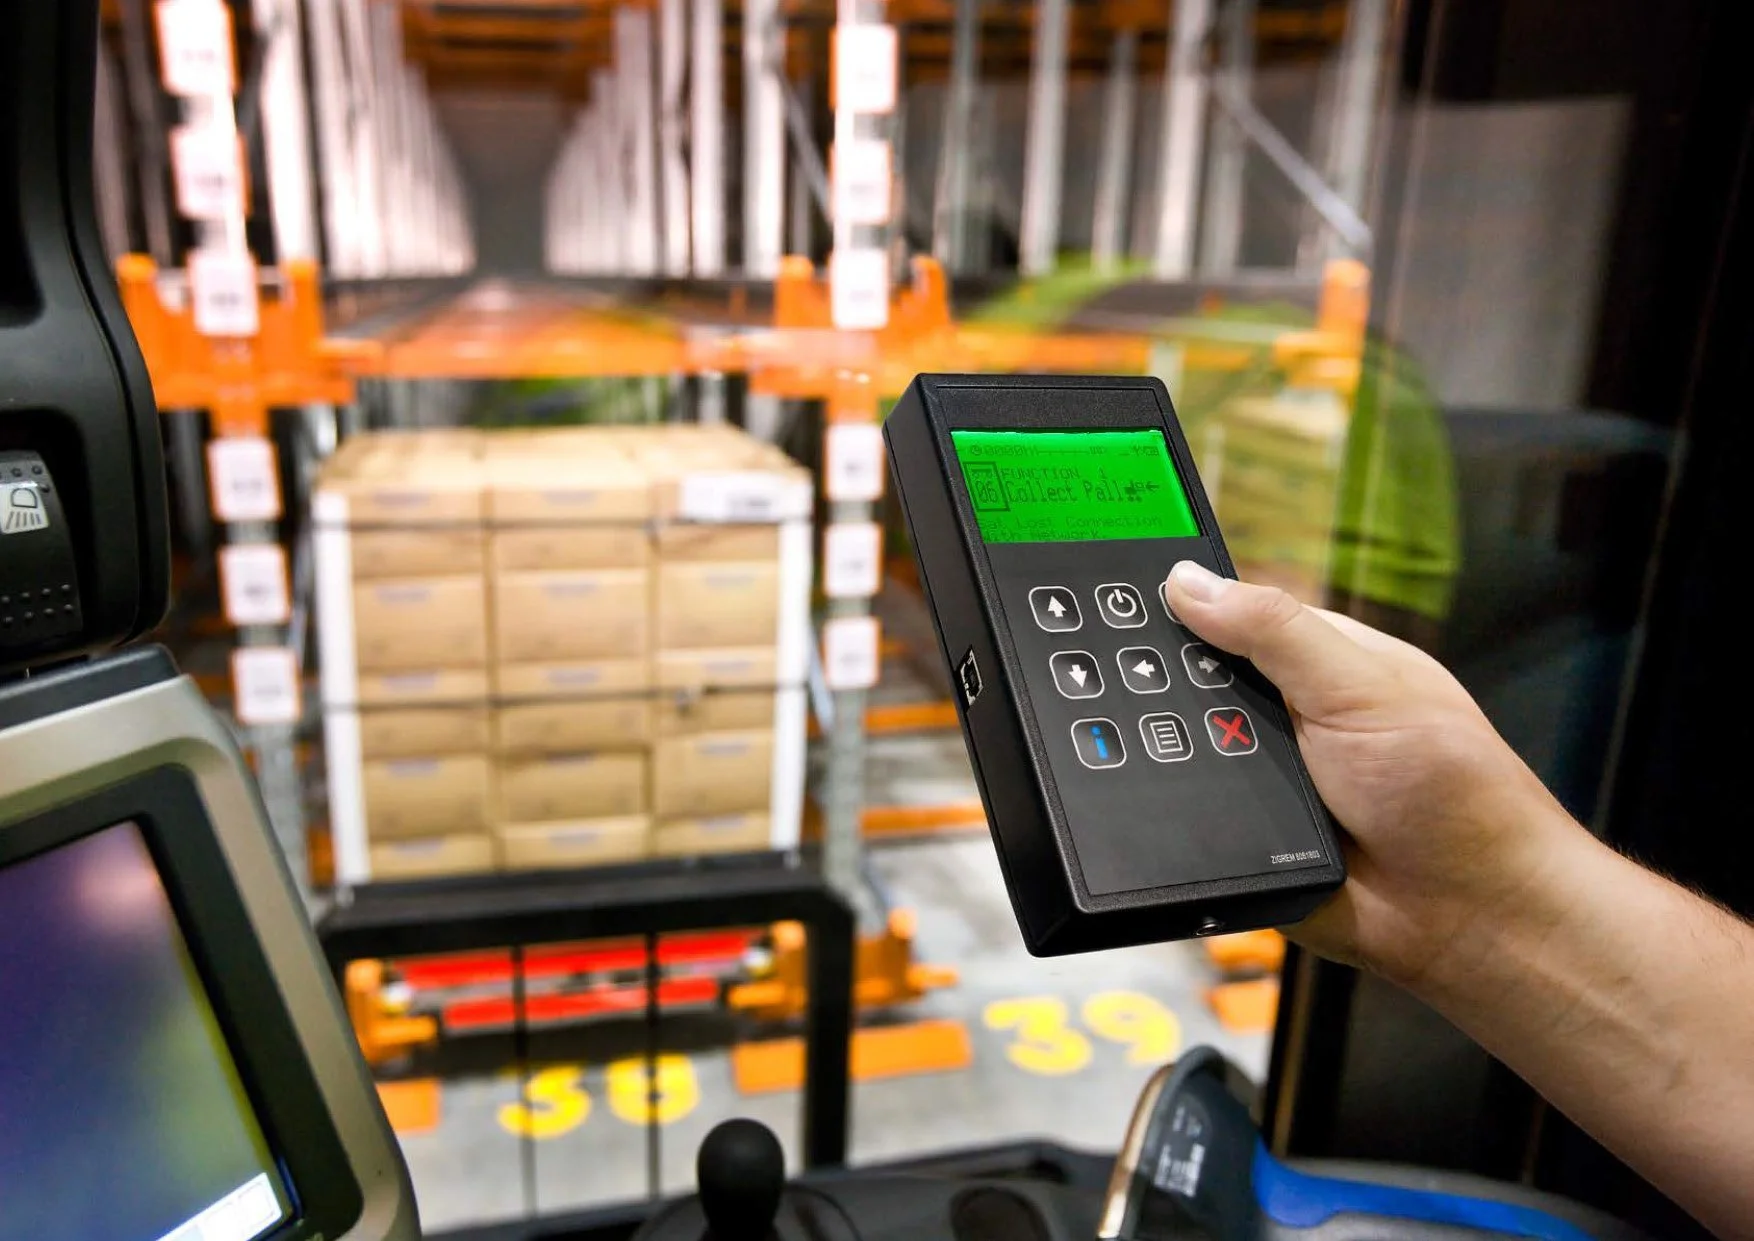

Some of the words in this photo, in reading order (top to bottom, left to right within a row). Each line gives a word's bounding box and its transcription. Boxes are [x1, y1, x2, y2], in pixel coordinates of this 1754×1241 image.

[1000, 468, 1080, 480] FUNCTION
[1006, 480, 1078, 502] Collect
[1066, 516, 1162, 527] Connection
[985, 991, 1181, 1074] 39
